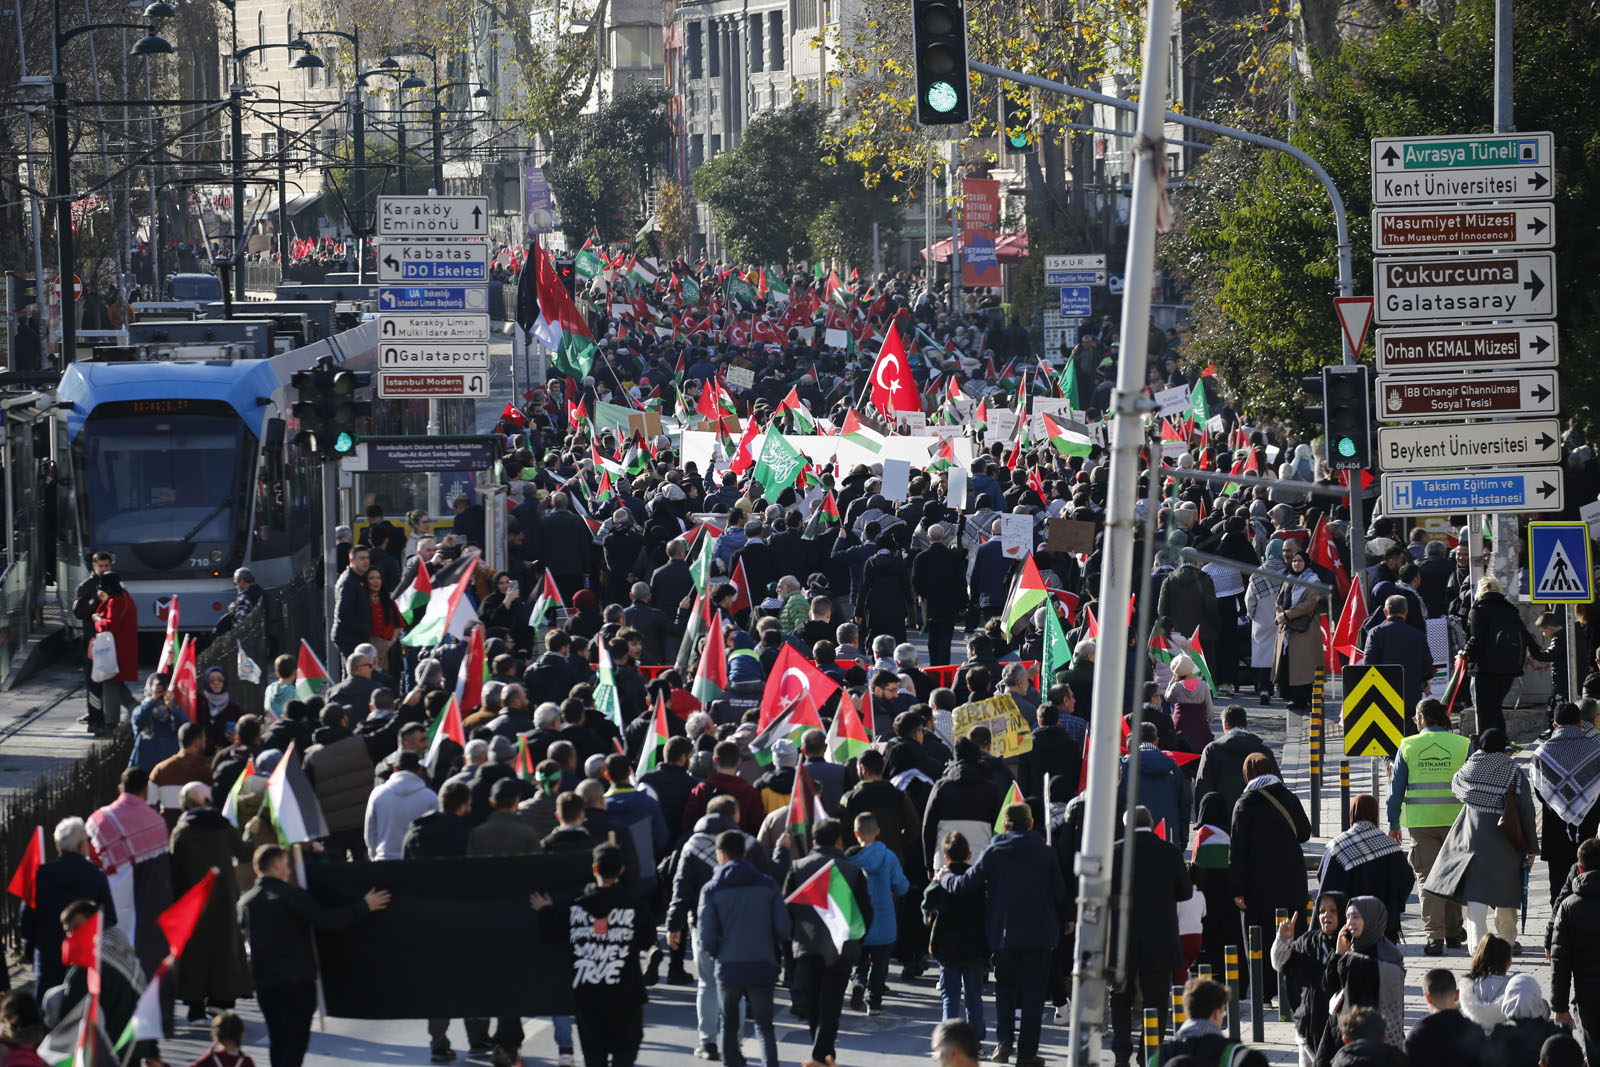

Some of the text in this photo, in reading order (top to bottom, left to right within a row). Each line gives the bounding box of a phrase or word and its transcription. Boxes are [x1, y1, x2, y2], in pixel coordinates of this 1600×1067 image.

[1405, 142, 1517, 165] Avrasya Tüneli
[1384, 174, 1518, 198] Kent Üniversitesi
[384, 202, 452, 218] Karaköy
[384, 218, 458, 230] Eminönü
[1384, 214, 1514, 234] Masumiyet Müzesi
[1384, 234, 1405, 244] (The
[1408, 233, 1447, 242] Museum
[403, 248, 472, 260] Kabataş
[402, 262, 484, 276] İDO İskelesi
[1390, 266, 1514, 288] Çukurcuma
[1386, 294, 1517, 312] Galatasaray
[400, 350, 485, 363] Galataport
[1386, 339, 1518, 360] Orhan KEMAL Müzesi
[386, 378, 424, 386] İstanbul
[1404, 385, 1518, 399] İBB Cihangir Cihannüması
[1431, 398, 1492, 411] Sosyal Tesisi
[1390, 435, 1528, 463] Beykent Üniversitesi
[1424, 482, 1461, 492] Taksim
[1464, 480, 1497, 492] Eğitim
[1501, 480, 1514, 489] ve
[1416, 494, 1522, 508] Araştırma Hastanesi
[190, 558, 210, 567] 710
